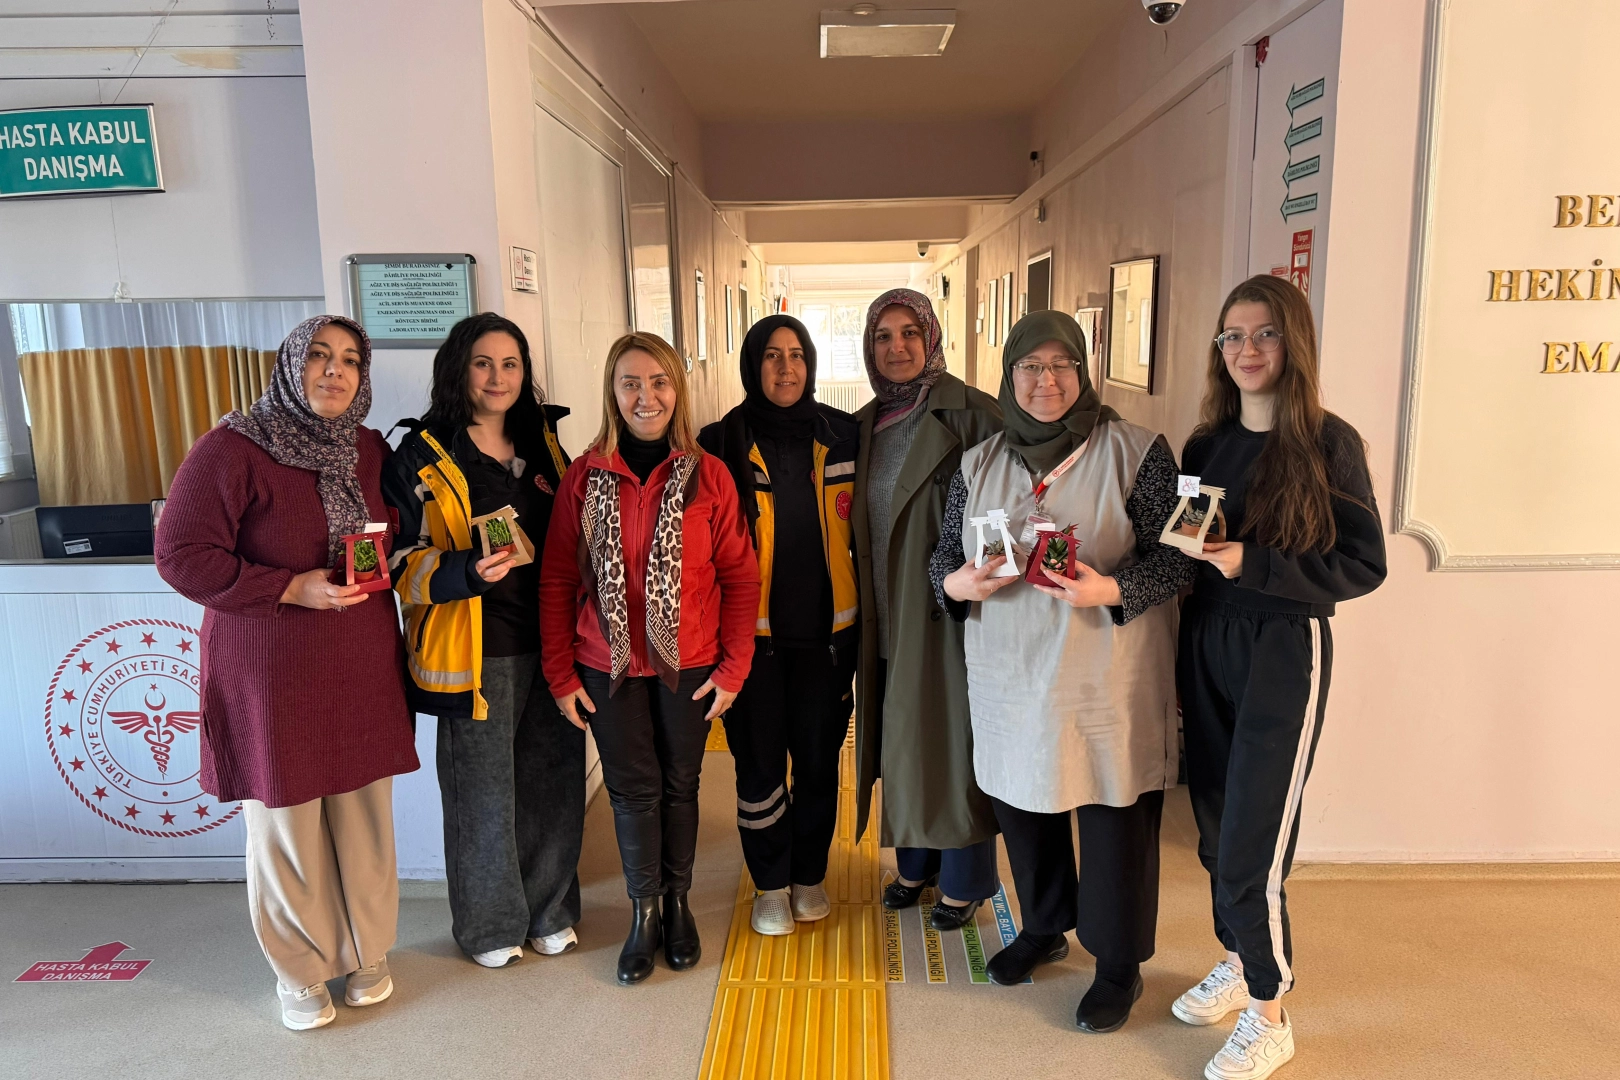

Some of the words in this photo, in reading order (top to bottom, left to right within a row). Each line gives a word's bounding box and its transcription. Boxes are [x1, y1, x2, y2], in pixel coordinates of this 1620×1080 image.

[0, 123, 64, 149] HASTA
[68, 121, 146, 145] KABUL
[23, 154, 124, 181] DANIŞMA
[1552, 194, 1620, 229] BE
[87, 659, 165, 726] CUMHURİYETİ
[88, 731, 132, 789] TÜRKİYE
[995, 902, 1006, 913] WC
[999, 918, 1013, 932] BAY
[34, 963, 86, 971] HASTA
[87, 962, 139, 971] KABUL
